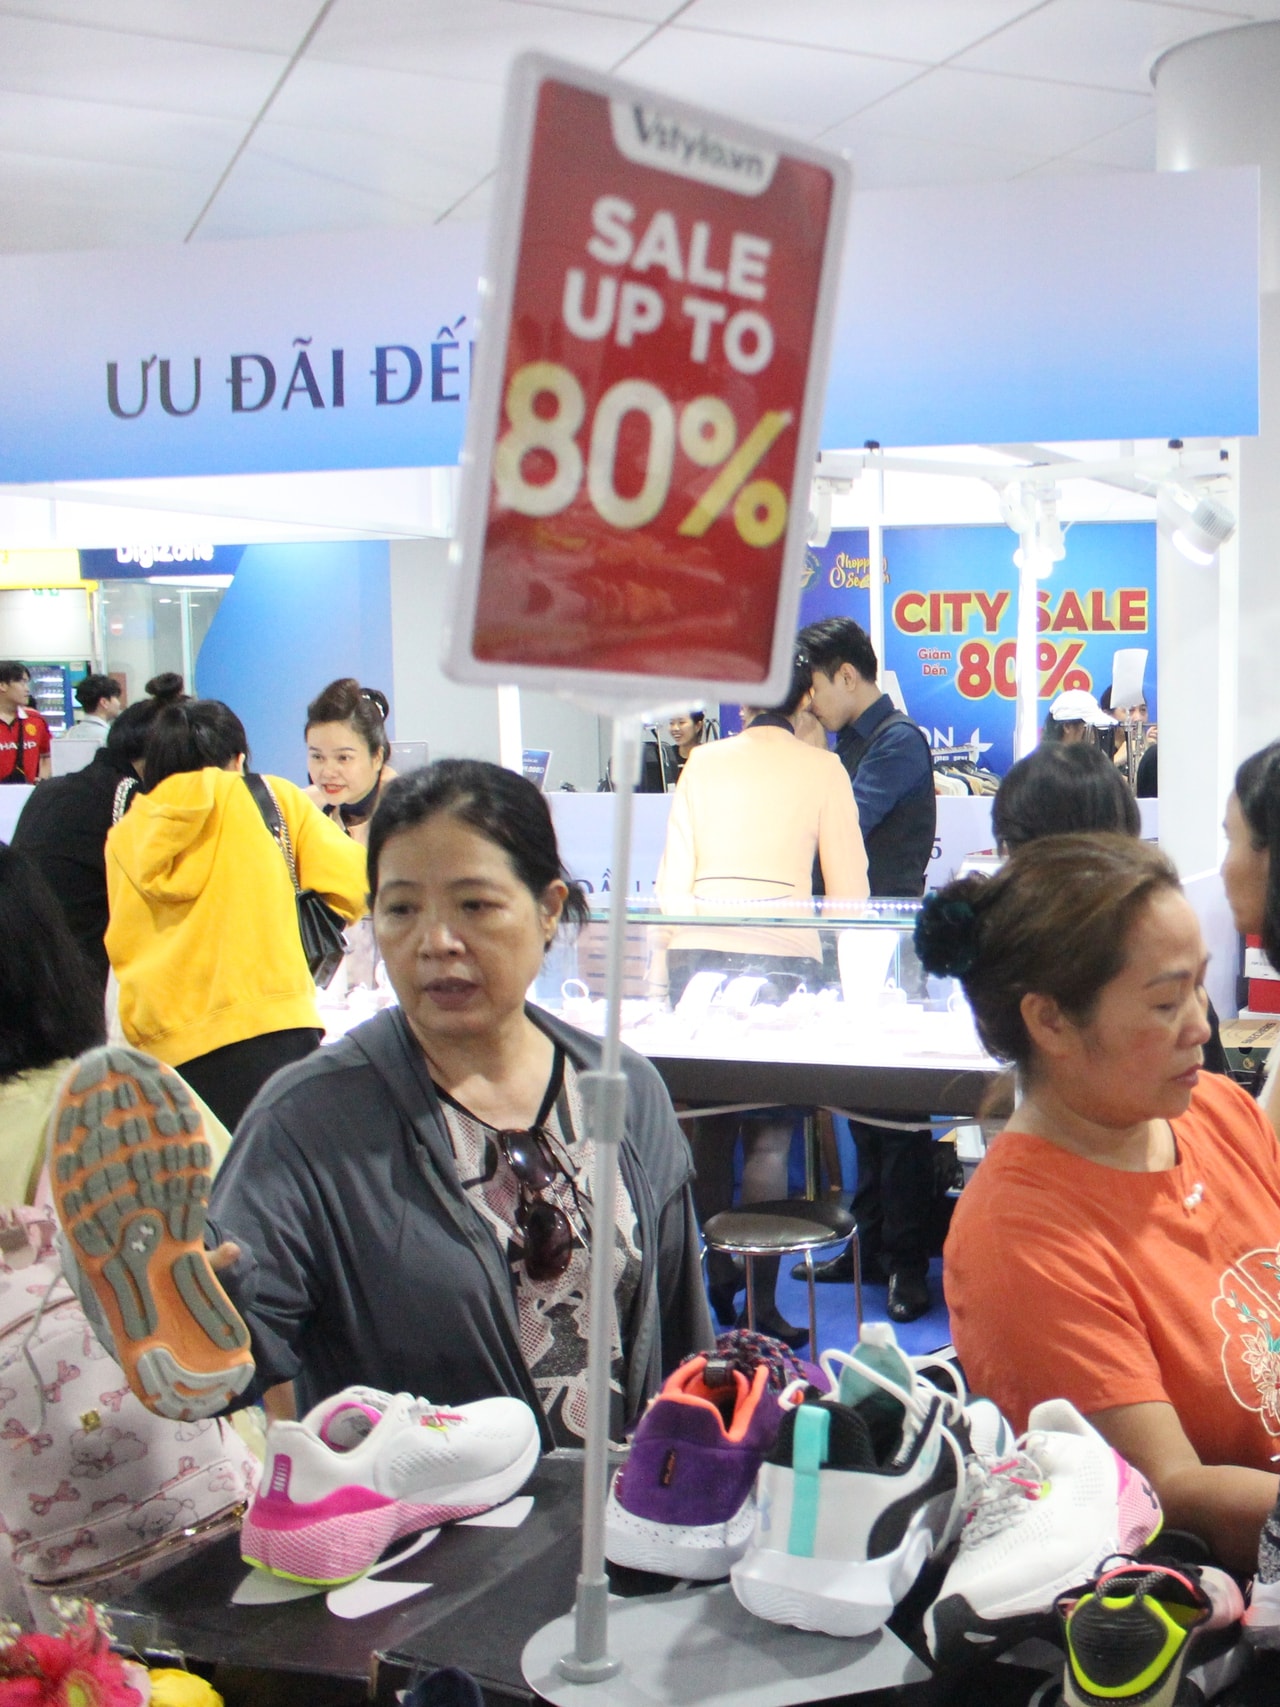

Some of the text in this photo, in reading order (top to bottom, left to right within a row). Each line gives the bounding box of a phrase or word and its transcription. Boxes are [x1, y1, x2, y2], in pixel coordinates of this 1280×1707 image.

[587, 195, 773, 301] SALE
[107, 315, 477, 420] ƯU ĐÃI ĐẾ
[561, 266, 775, 375] UP TO
[494, 360, 795, 549] 80%
[896, 589, 1148, 634] CITY SALE
[956, 640, 1093, 700] 80%
